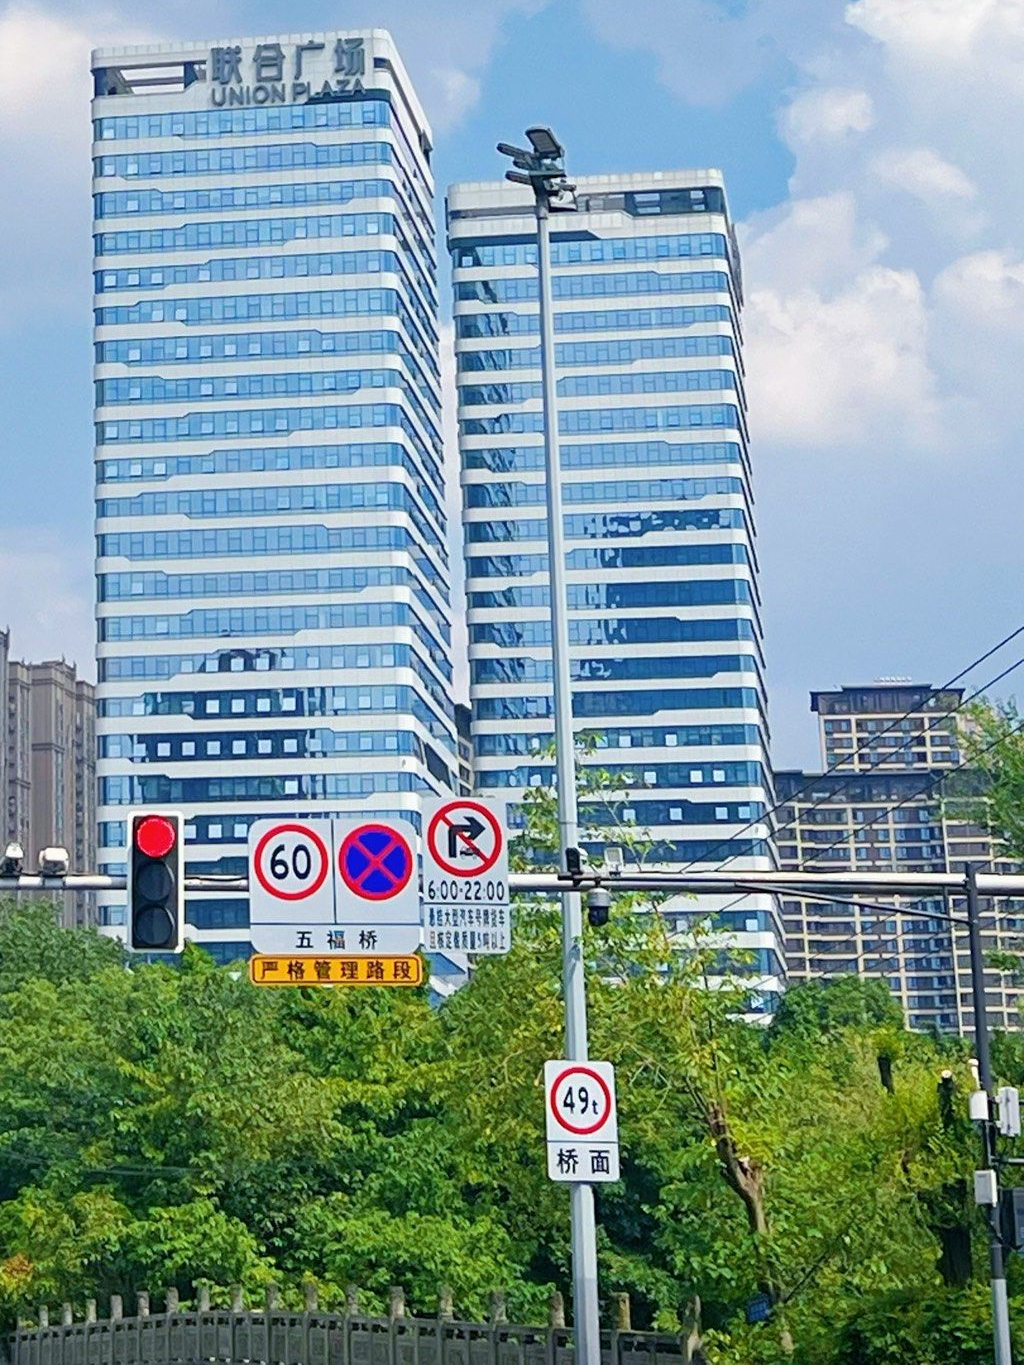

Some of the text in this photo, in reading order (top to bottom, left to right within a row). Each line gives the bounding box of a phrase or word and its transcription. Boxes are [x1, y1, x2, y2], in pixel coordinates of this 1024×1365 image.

[210, 37, 365, 84] 联合广场
[211, 78, 367, 107] UNION PLAZA
[269, 843, 312, 881] 60
[295, 930, 378, 950] 五福桥
[260, 960, 412, 980] 严格管理路段
[556, 1148, 611, 1176] 桥面
